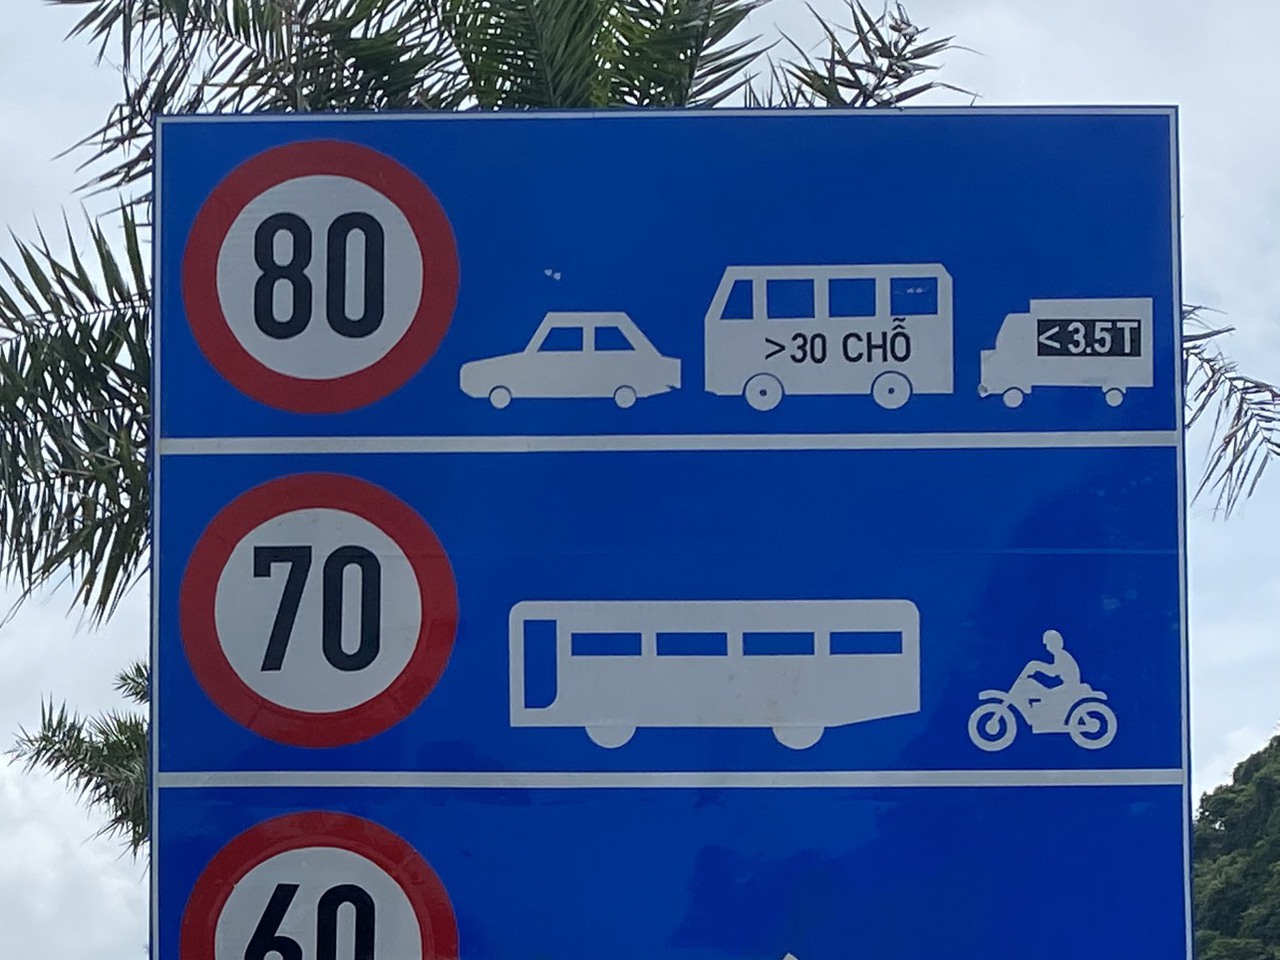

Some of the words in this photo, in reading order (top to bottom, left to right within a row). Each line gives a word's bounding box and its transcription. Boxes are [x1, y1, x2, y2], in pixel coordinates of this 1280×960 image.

[253, 211, 385, 341] 80
[764, 331, 827, 365] >30
[841, 317, 912, 363] CHỖ
[252, 544, 382, 673] 70
